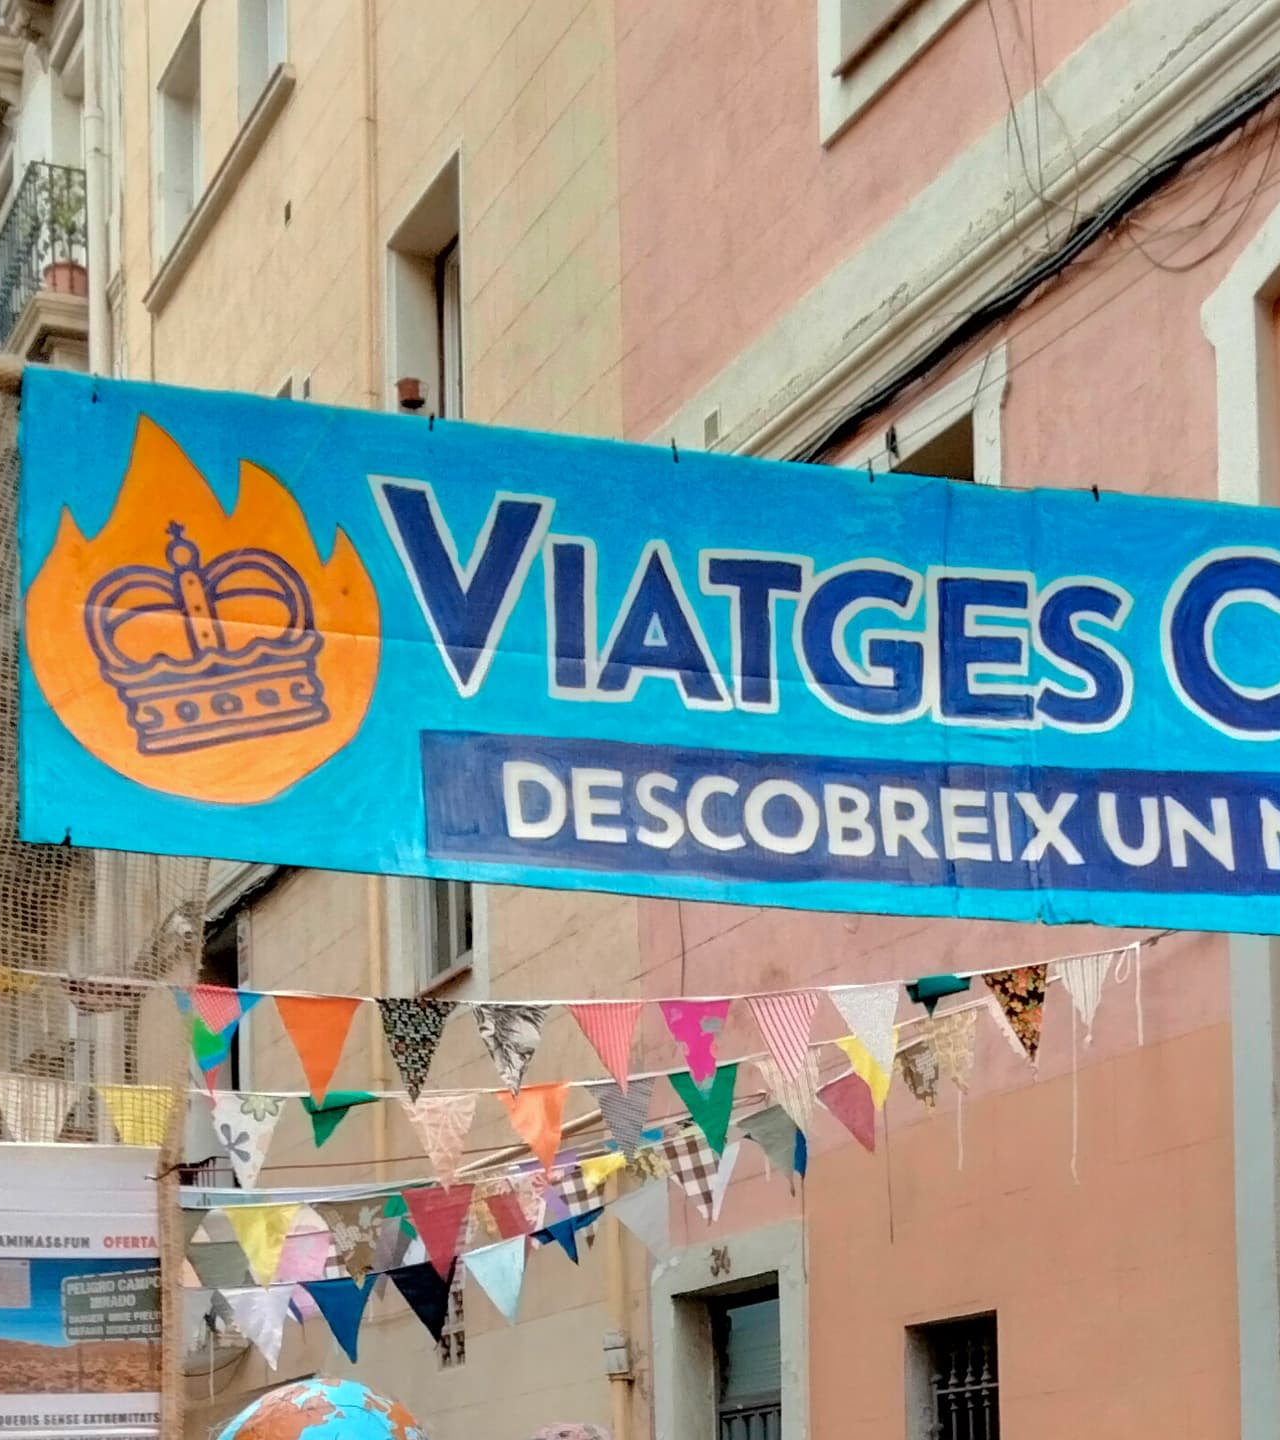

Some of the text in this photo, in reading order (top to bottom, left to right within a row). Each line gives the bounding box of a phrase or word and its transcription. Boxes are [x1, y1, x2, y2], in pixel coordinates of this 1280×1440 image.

[367, 474, 1134, 735] VIATGES
[502, 760, 1086, 866] DESCOBREIX
[1098, 791, 1234, 870] UN
[103, 1236, 160, 1249] OFERTA
[67, 1279, 115, 1295] PELIGRO
[43, 1413, 79, 1425] SENSE
